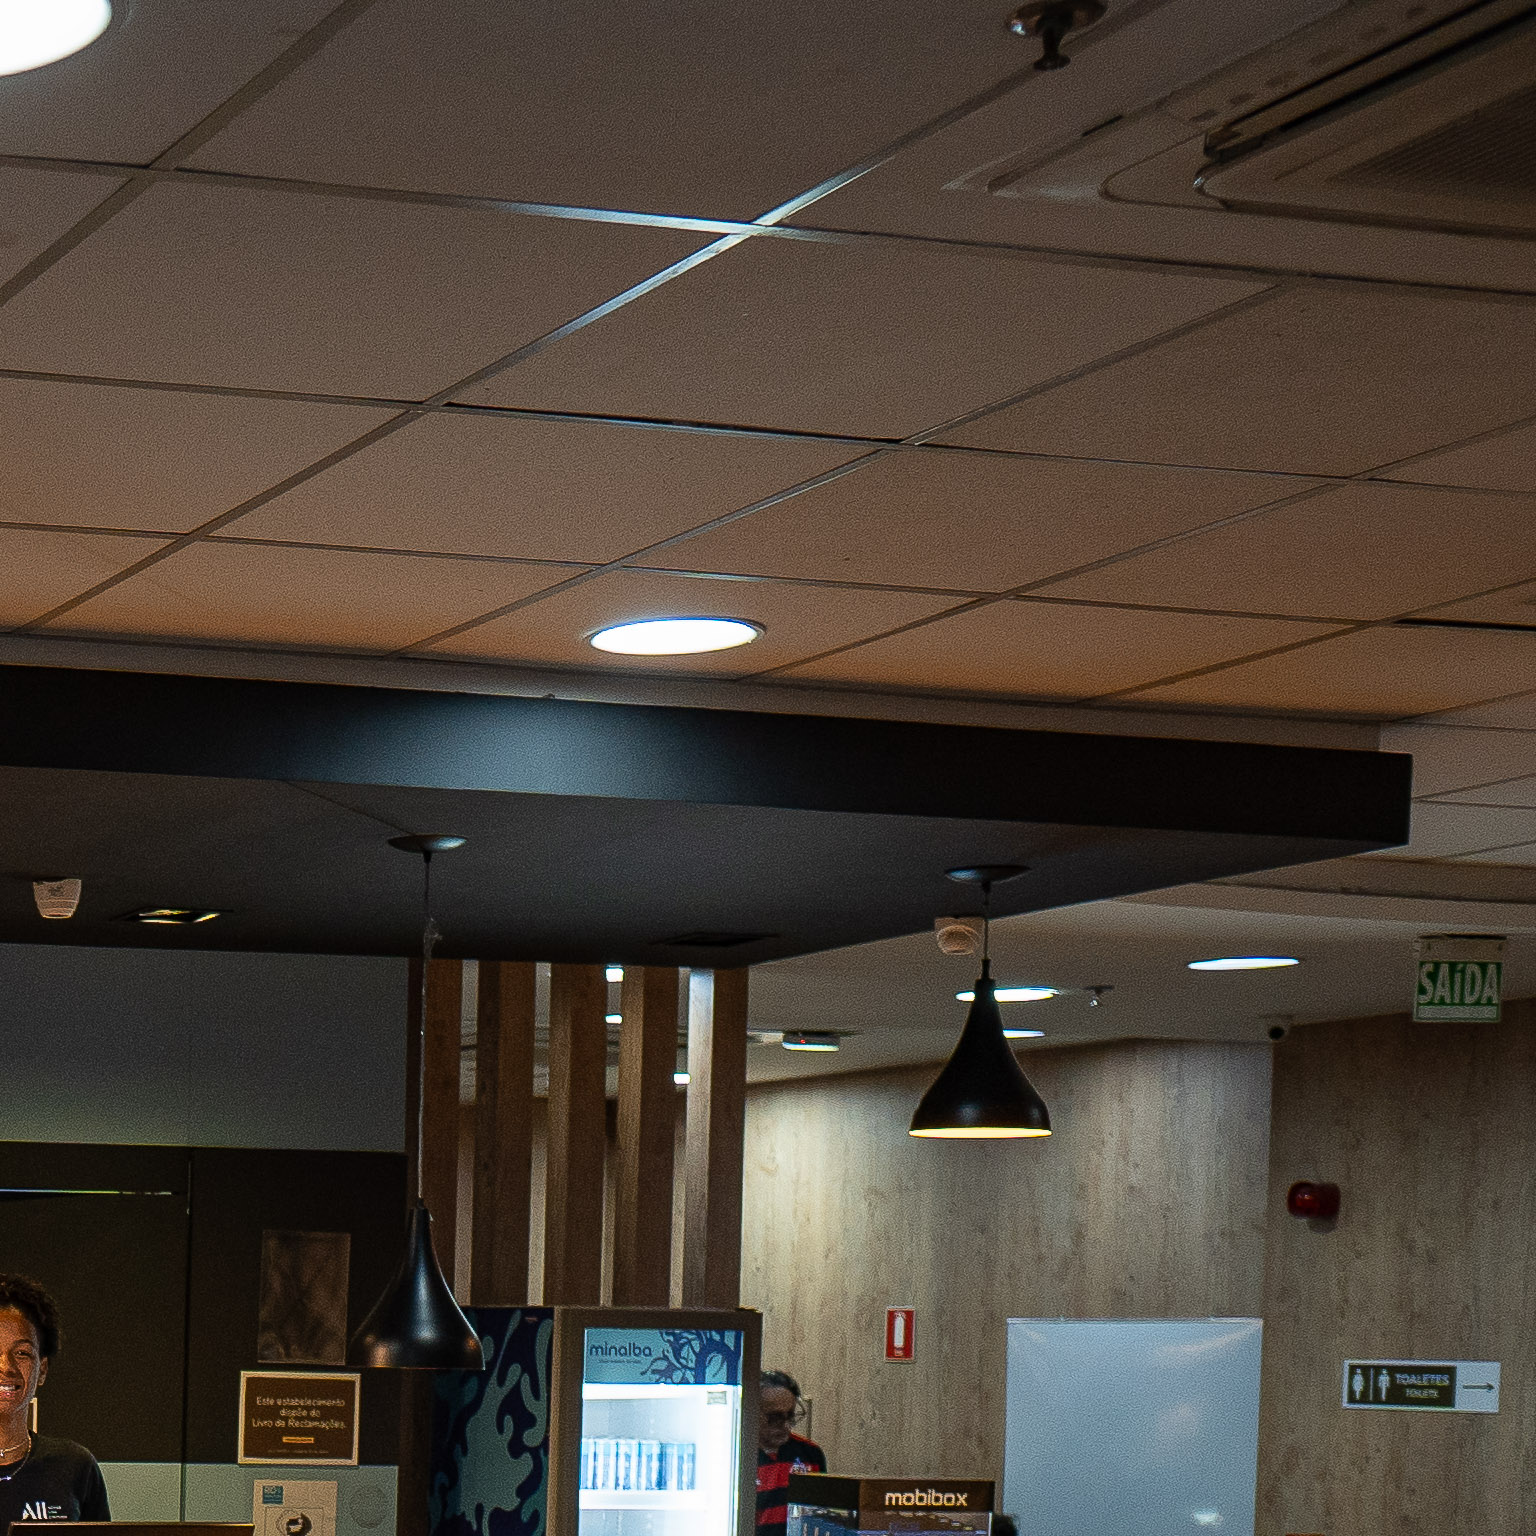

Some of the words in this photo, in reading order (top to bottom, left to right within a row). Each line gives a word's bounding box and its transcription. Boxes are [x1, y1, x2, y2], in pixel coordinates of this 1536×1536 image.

[1418, 963, 1499, 1004] SAÍDA
[589, 1342, 653, 1357] minalba
[884, 1489, 968, 1507] mobibox
